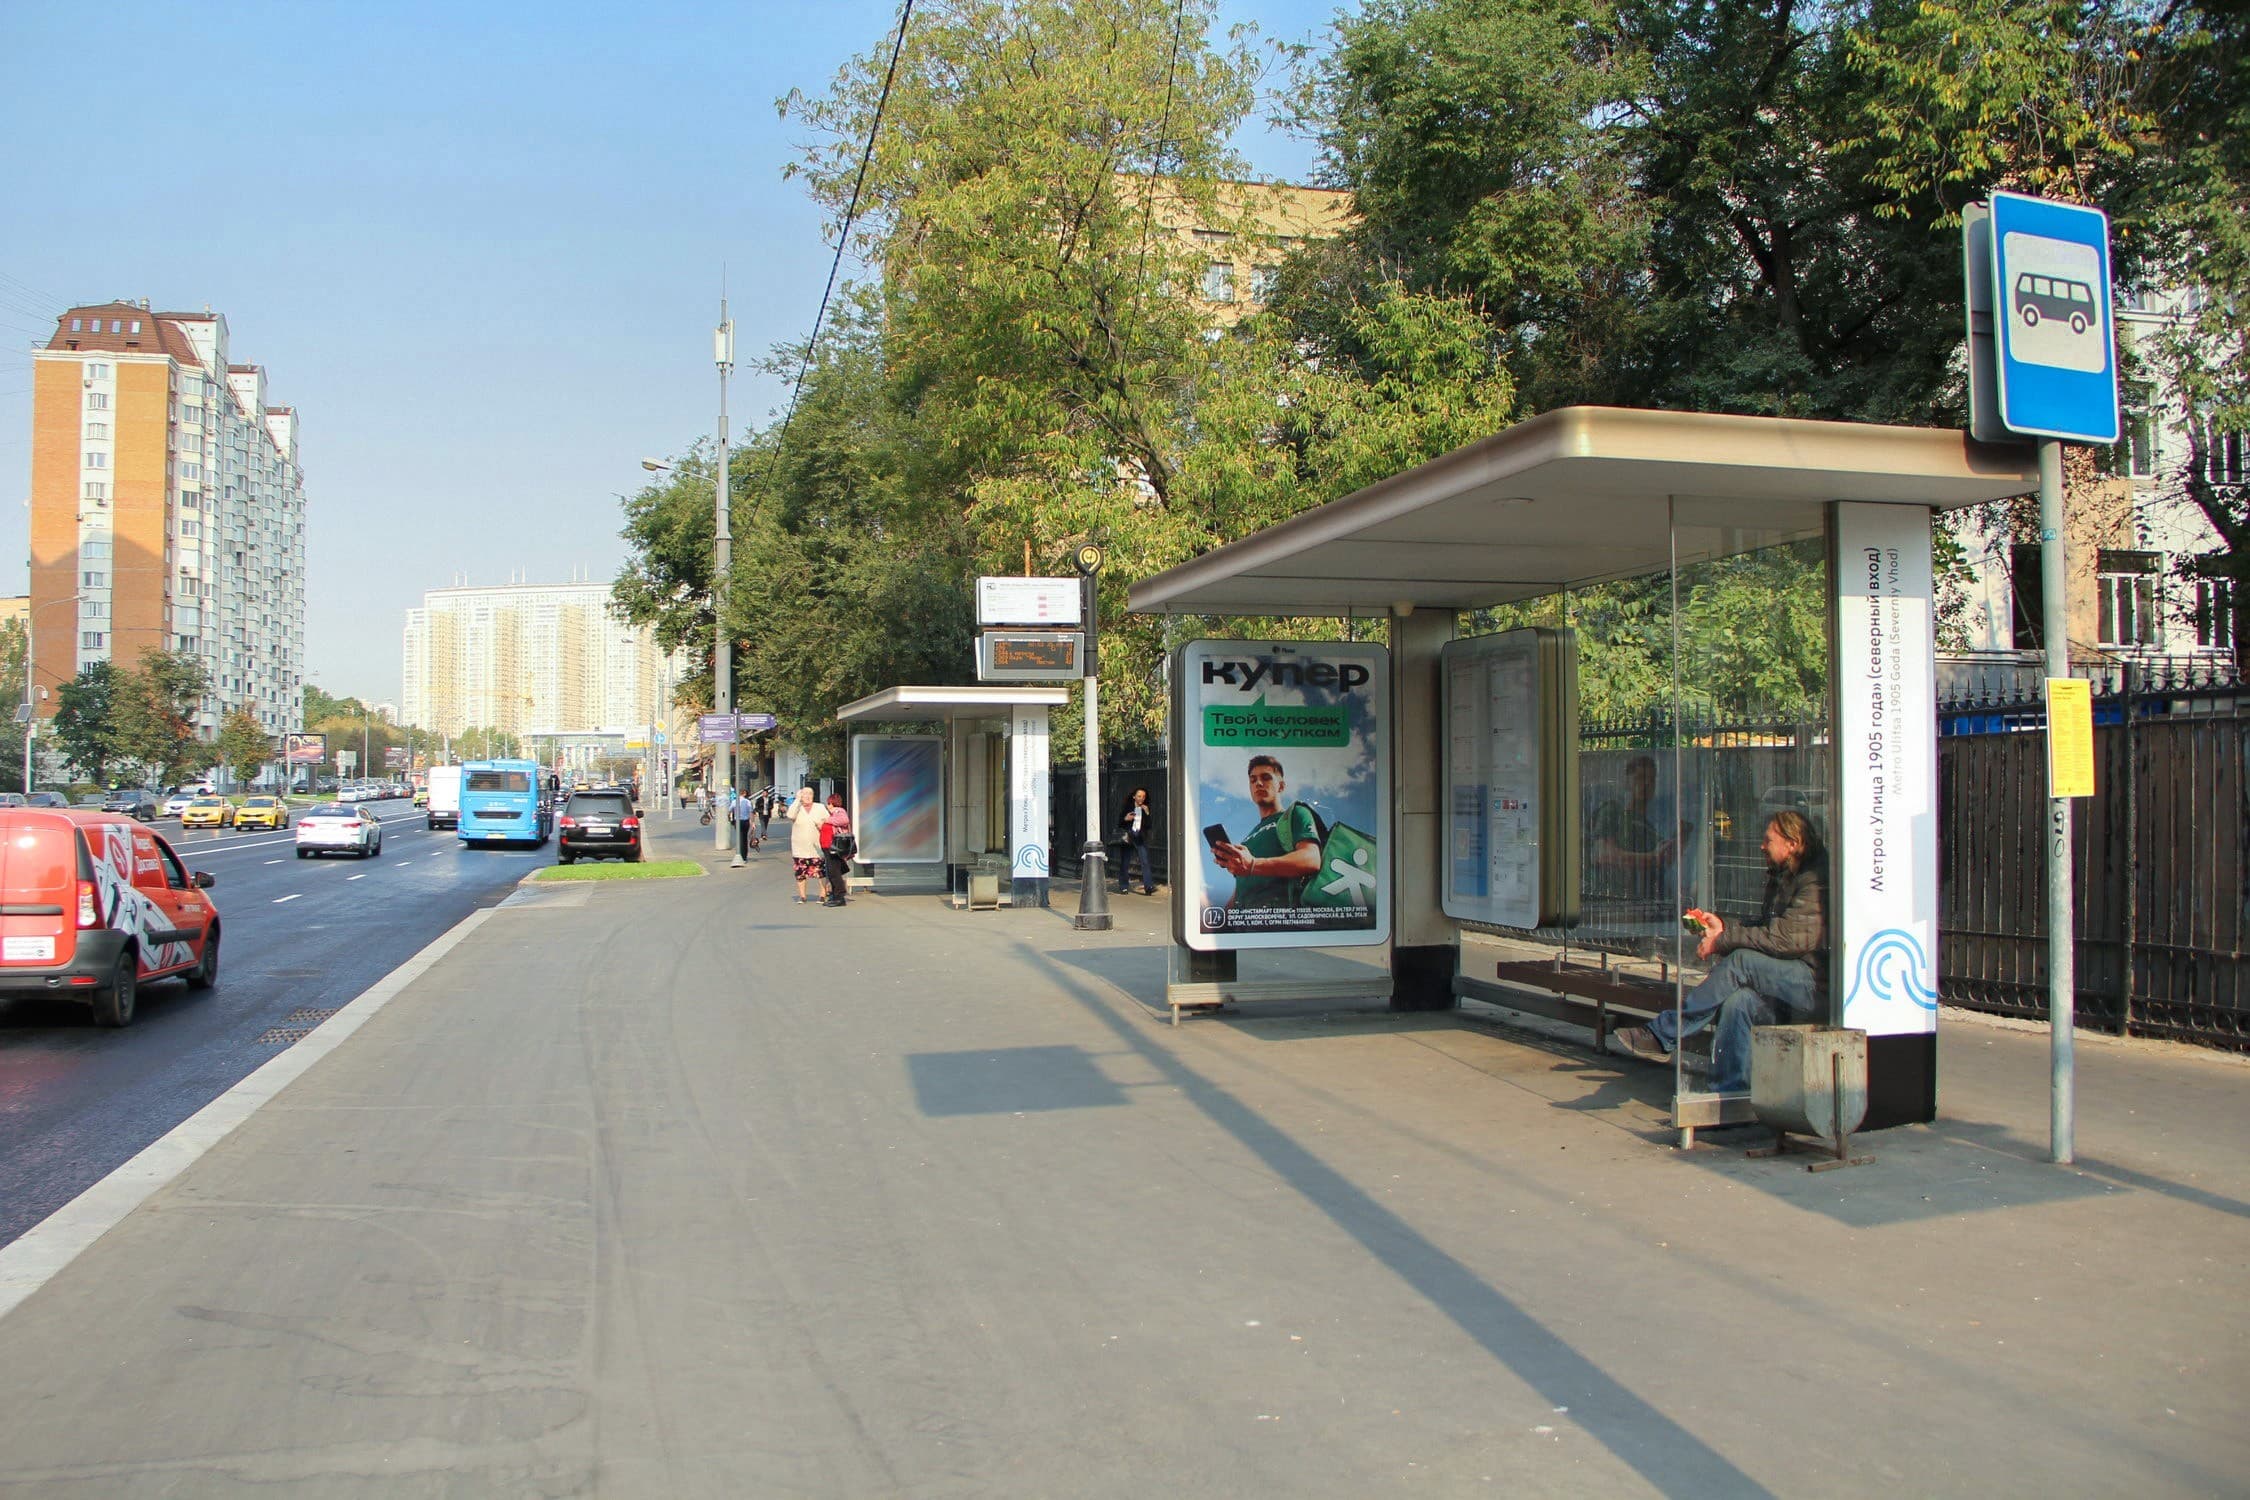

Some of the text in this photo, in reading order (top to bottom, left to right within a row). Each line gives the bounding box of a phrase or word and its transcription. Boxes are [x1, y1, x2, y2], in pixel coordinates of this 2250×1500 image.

[1864, 547, 1881, 590] вход)
[1887, 548, 1899, 584] Vhod)
[1888, 586, 1902, 644] (Severniy
[1867, 596, 1884, 679] (северный
[1203, 662, 1370, 692] купер
[1890, 648, 1901, 680] Goda
[1872, 683, 1884, 727] года»
[1891, 685, 1901, 713] 1905
[1211, 713, 1340, 725] Твой человек
[1213, 728, 1340, 739] по покупкам
[1869, 732, 1883, 771] 1905
[1870, 838, 1886, 892] Метро
[1207, 910, 1222, 925] 12+
